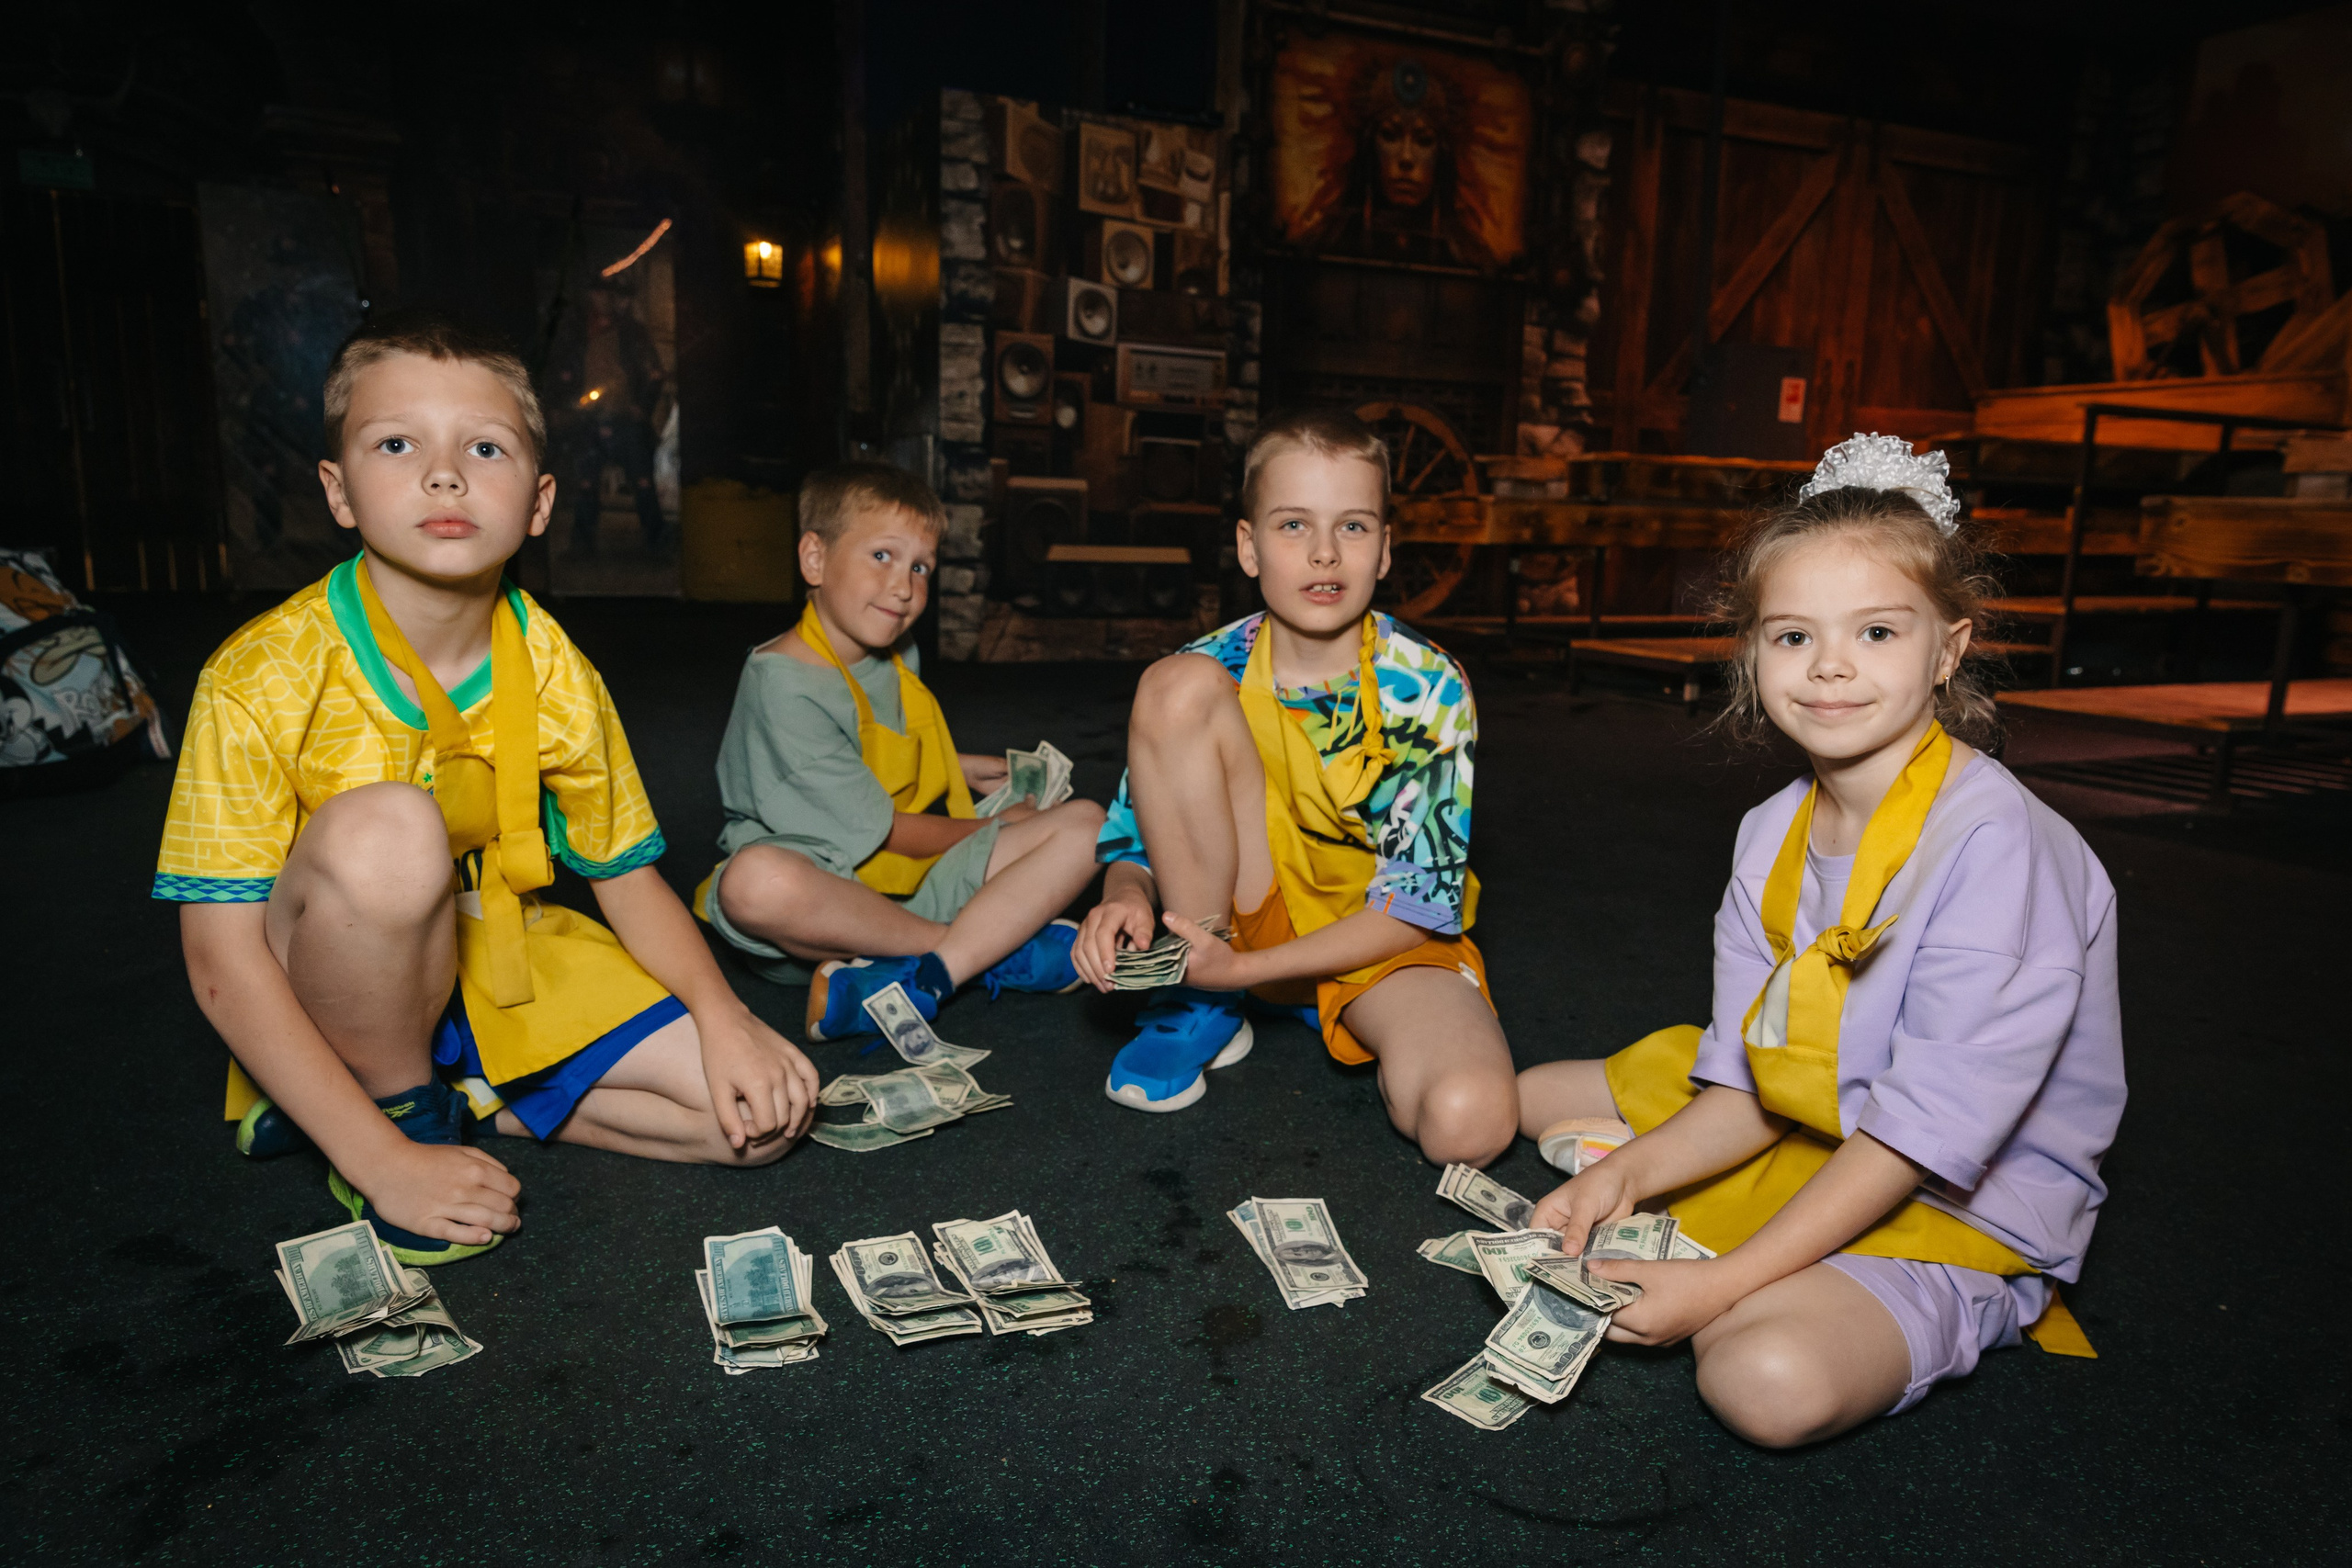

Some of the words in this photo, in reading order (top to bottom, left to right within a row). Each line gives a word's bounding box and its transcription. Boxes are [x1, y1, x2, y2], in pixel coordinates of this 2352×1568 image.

[1653, 1219, 1665, 1233] 100
[293, 1265, 310, 1298] AMERICA
[366, 1257, 385, 1292] DOLLARS
[715, 1258, 724, 1287] AMERICA
[779, 1258, 788, 1289] DOLLARS
[1443, 1387, 1464, 1399] 100
